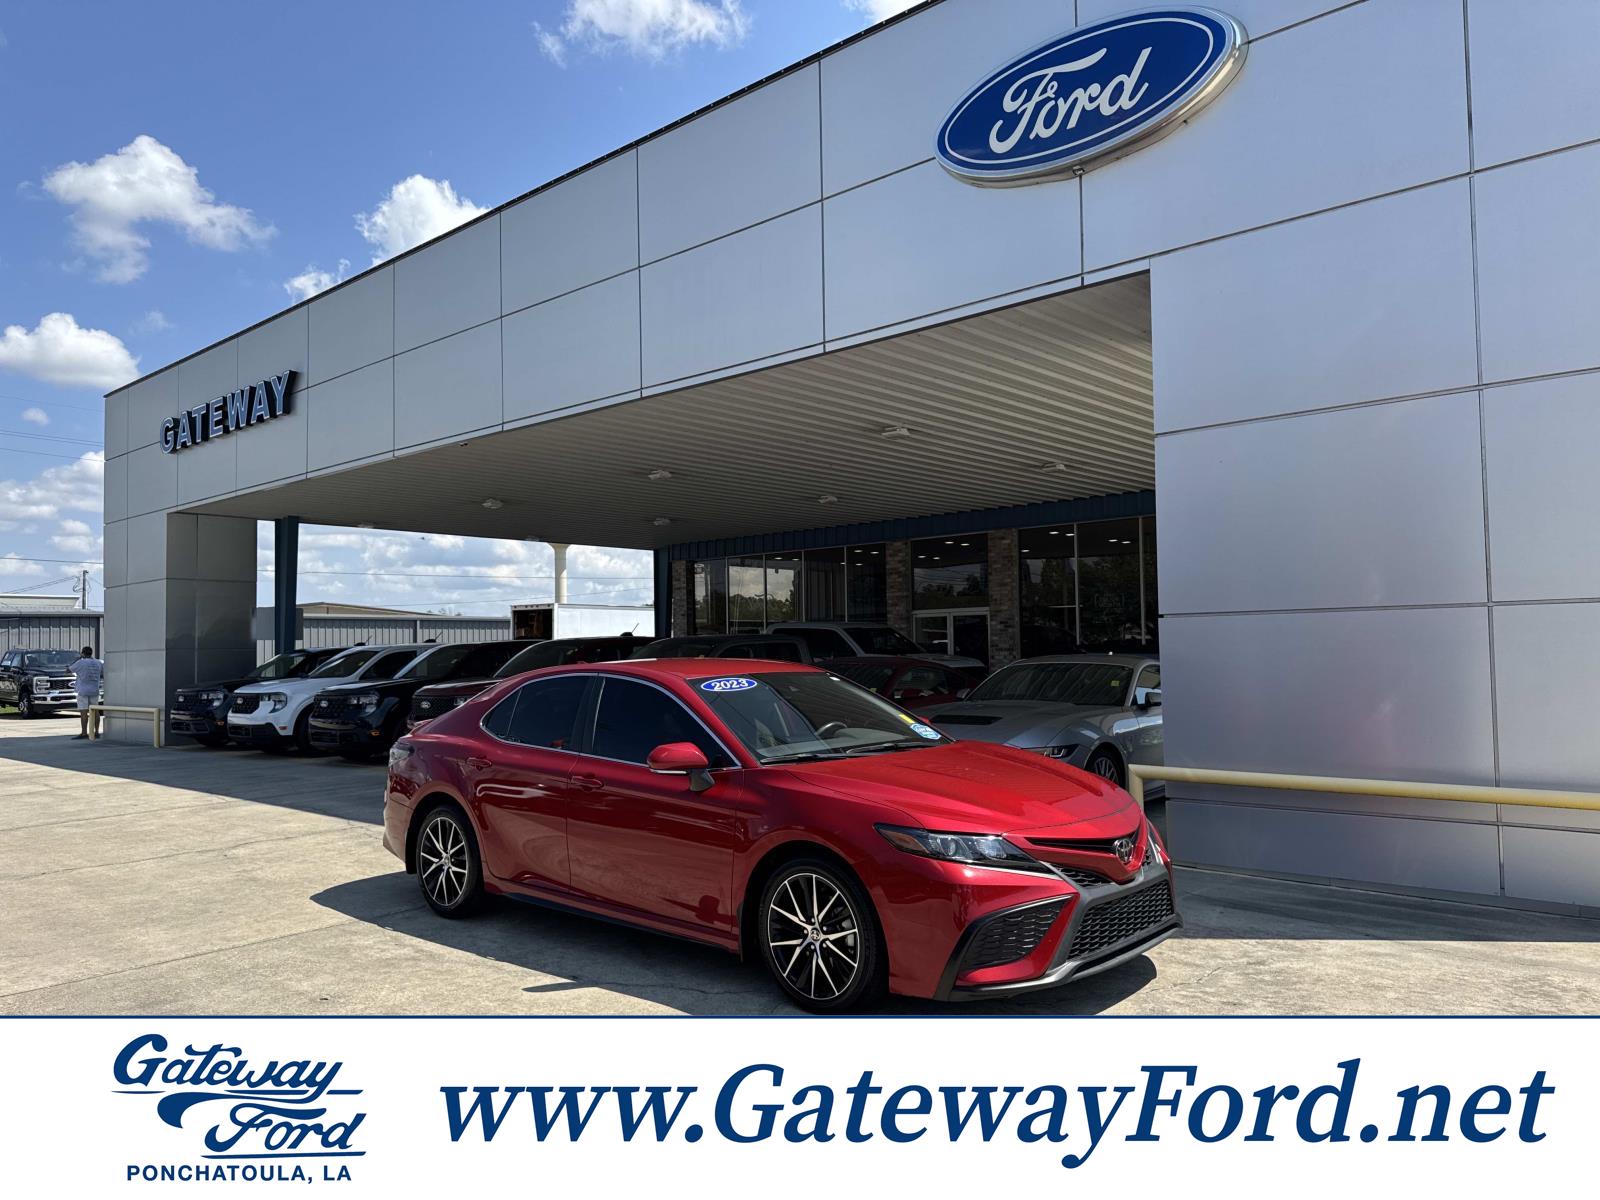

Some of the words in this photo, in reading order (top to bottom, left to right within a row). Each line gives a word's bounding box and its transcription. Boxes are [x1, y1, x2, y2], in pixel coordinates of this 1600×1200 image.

[988, 46, 1153, 154] Ford
[160, 370, 292, 454] GATEWAY
[711, 679, 749, 691] 2023
